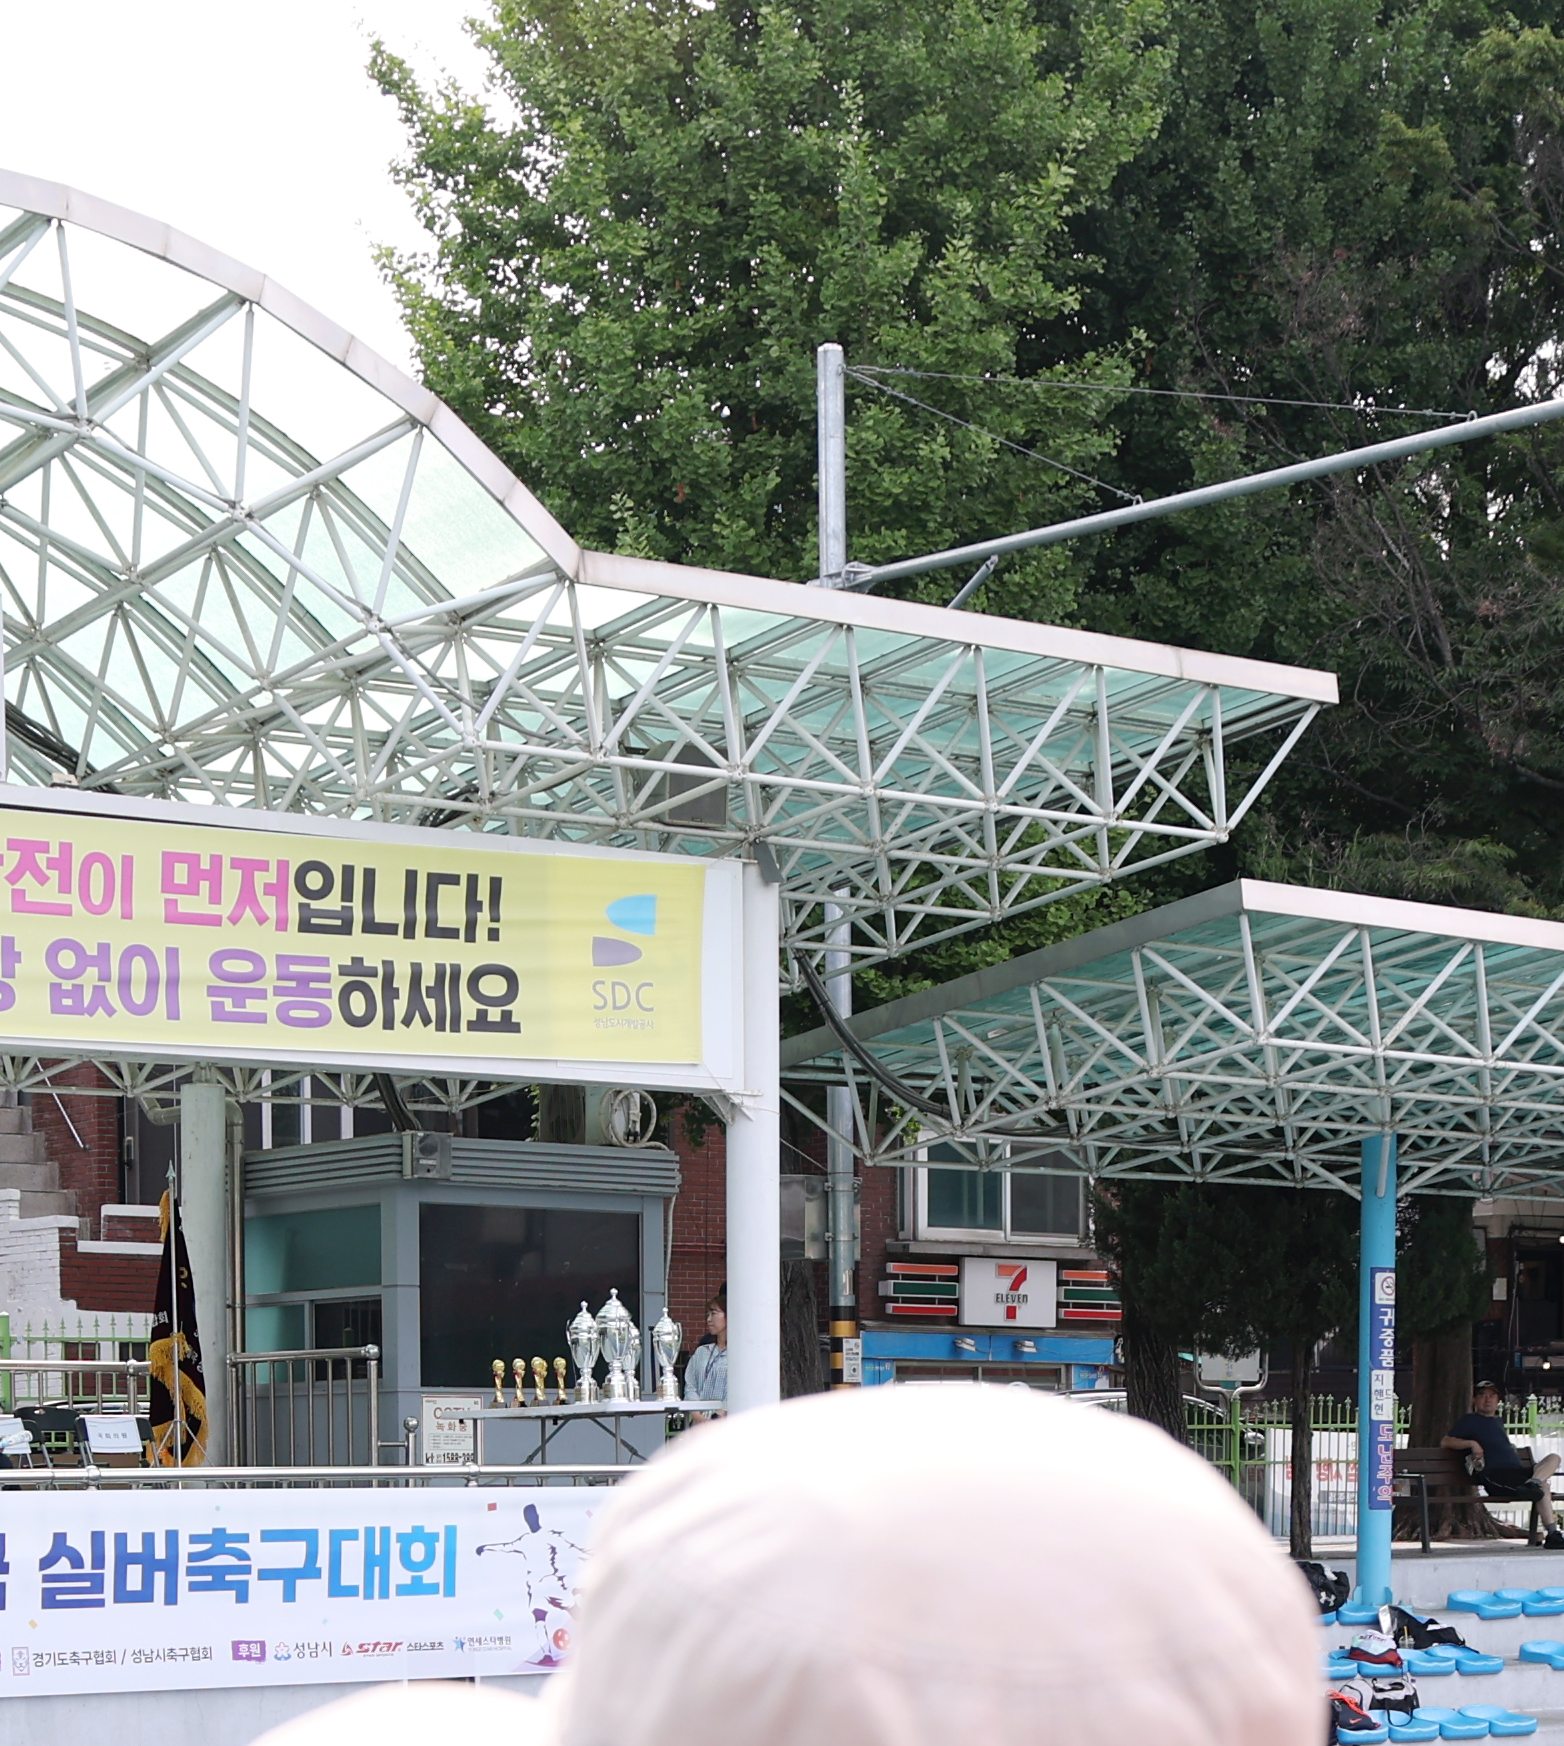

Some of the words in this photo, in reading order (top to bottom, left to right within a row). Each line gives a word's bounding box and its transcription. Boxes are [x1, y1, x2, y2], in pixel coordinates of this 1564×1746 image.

[160, 850, 503, 943] 먼저입니다!
[45, 937, 180, 1020] 없이
[206, 947, 522, 1035] 운동하세요
[592, 980, 654, 1012] SDC
[594, 1018, 654, 1029] 성남도시개발공사
[997, 1264, 1028, 1320] 7
[38, 1524, 459, 1610] 실버축구대회
[237, 1643, 262, 1659] 후원
[292, 1641, 332, 1659] 성남시
[406, 1642, 444, 1651] 스타스포츠
[467, 1636, 512, 1646] 연세스타병원
[32, 1650, 118, 1668] 경기도축구협회
[130, 1646, 213, 1664] 성남시축구협회
